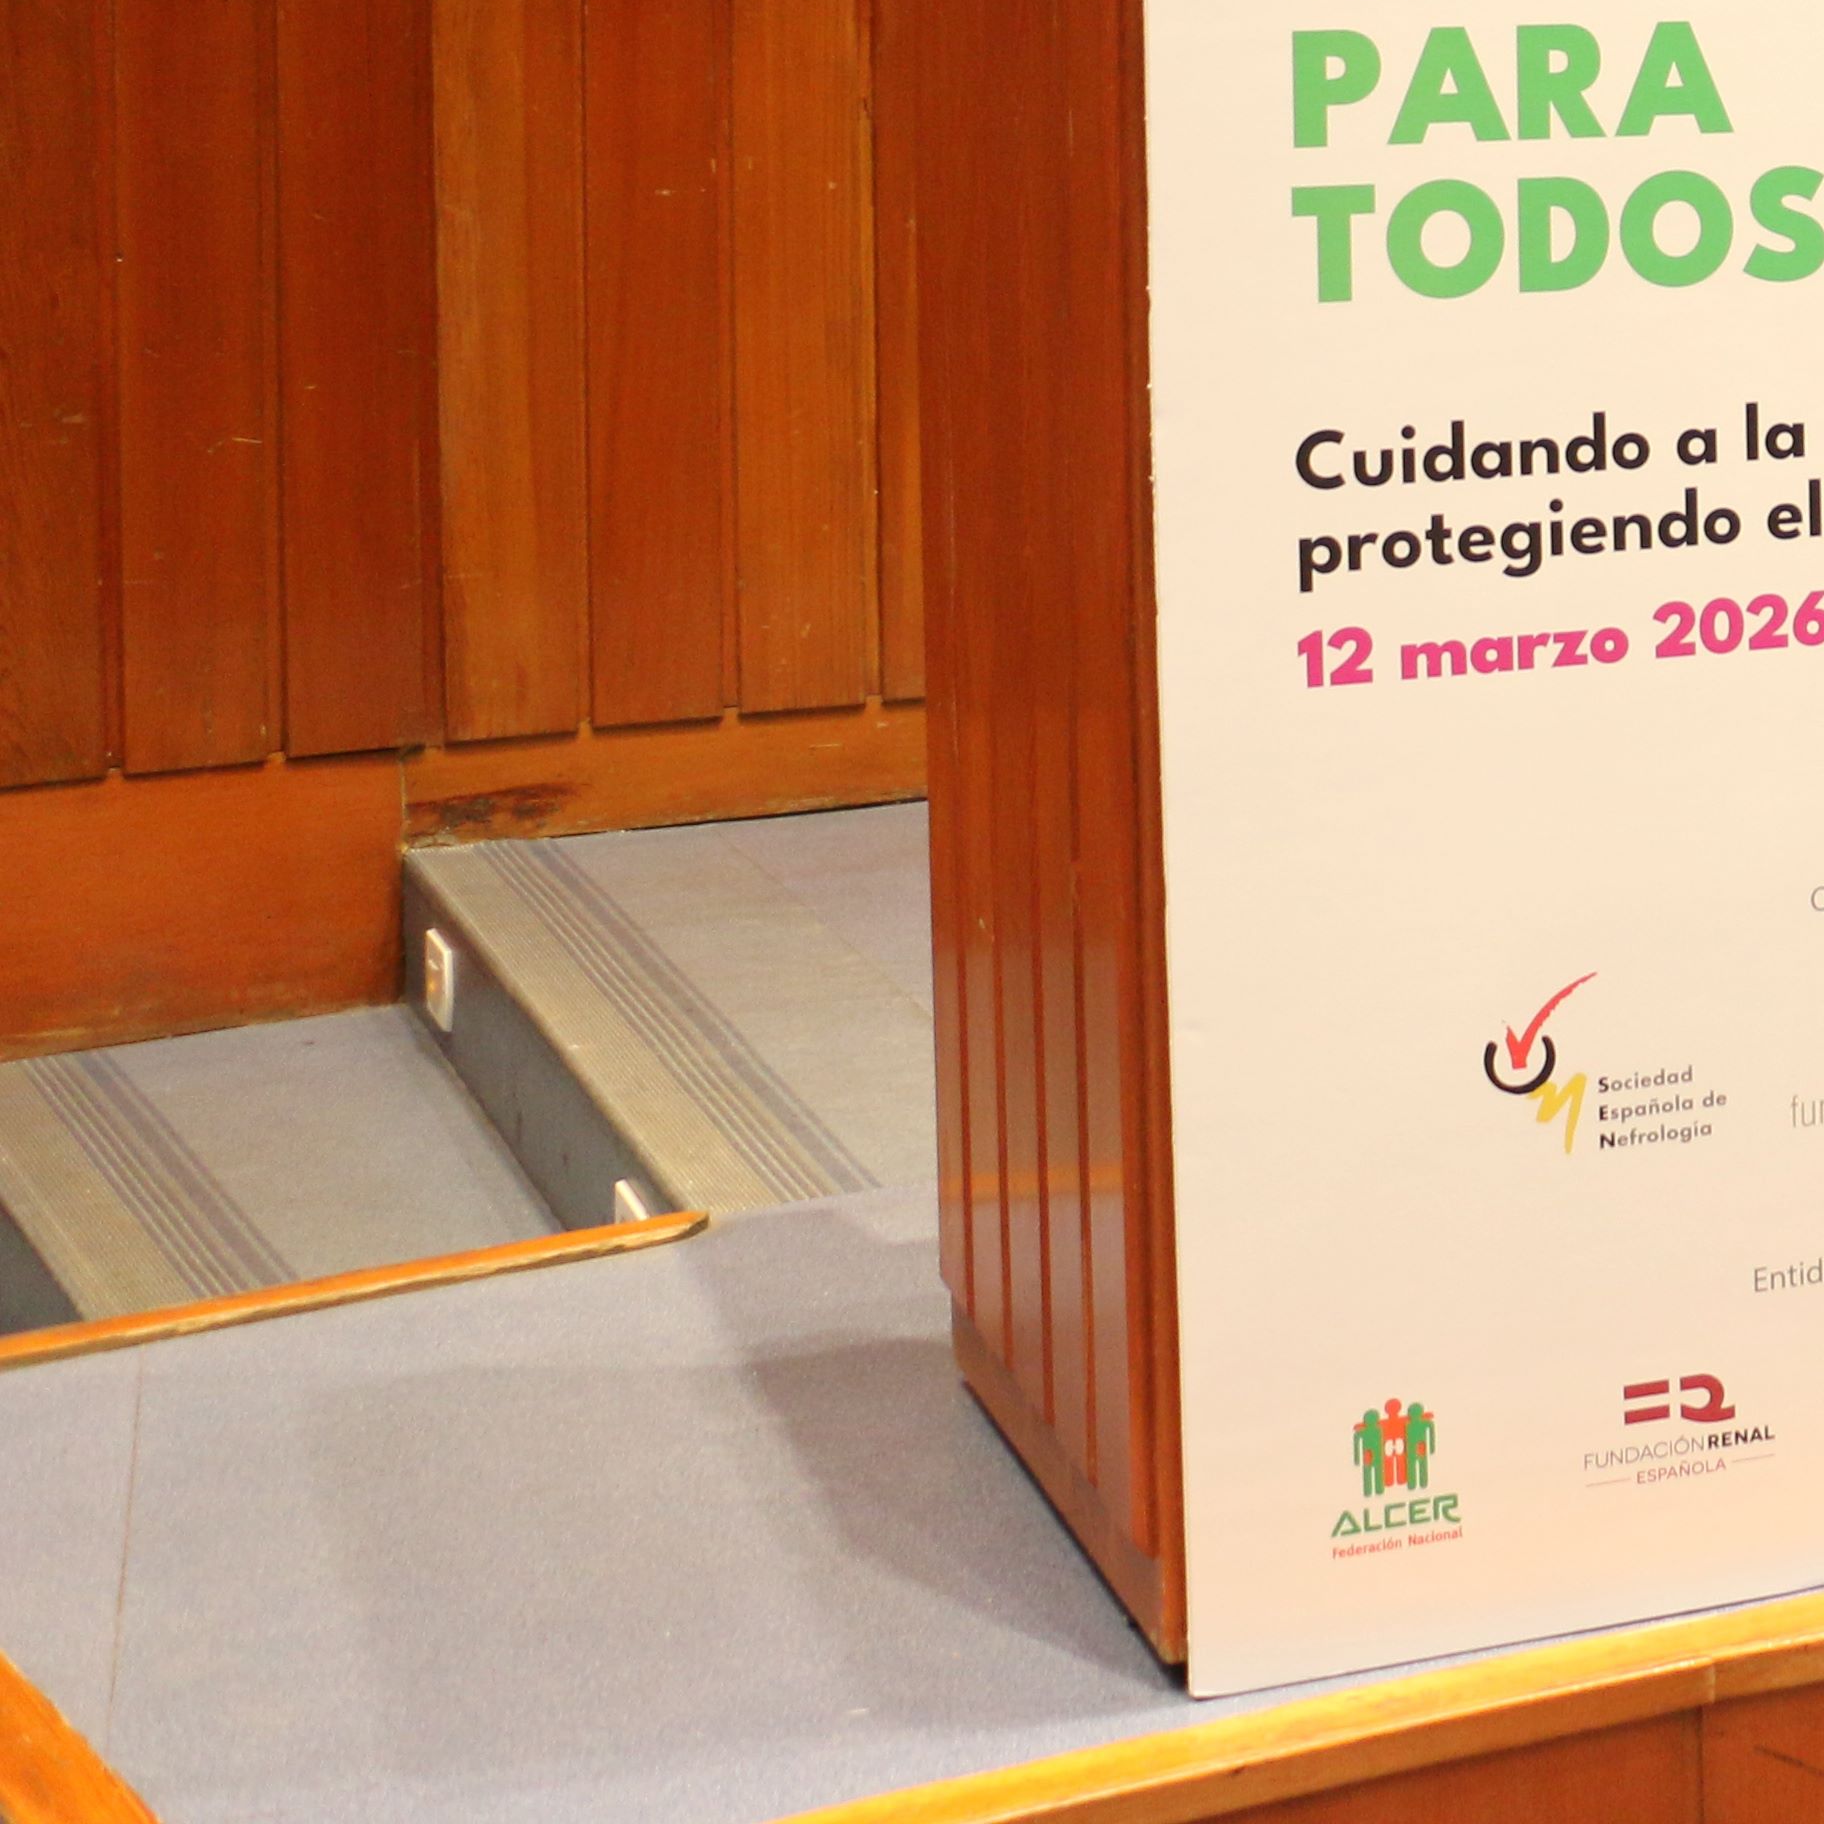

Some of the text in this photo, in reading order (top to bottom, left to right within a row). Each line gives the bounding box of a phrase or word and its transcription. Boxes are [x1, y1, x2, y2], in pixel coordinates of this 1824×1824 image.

[1291, 21, 1732, 149] PARA
[1295, 410, 1651, 491] Cuidando
[1676, 426, 1719, 466] a
[1745, 401, 1806, 462] la
[1298, 486, 1742, 594] protegiendo
[1767, 480, 1823, 540] el
[1296, 626, 1375, 689] 12
[1399, 621, 1630, 682] marzo
[1597, 1064, 1693, 1094] Sociedad
[1599, 1090, 1728, 1124] Española de
[1599, 1120, 1713, 1149] Nefrología
[1636, 1457, 1727, 1485] ESPAÑOLA
[1330, 1493, 1462, 1538] ALCER
[1332, 1526, 1463, 1559] Federación Nacional
